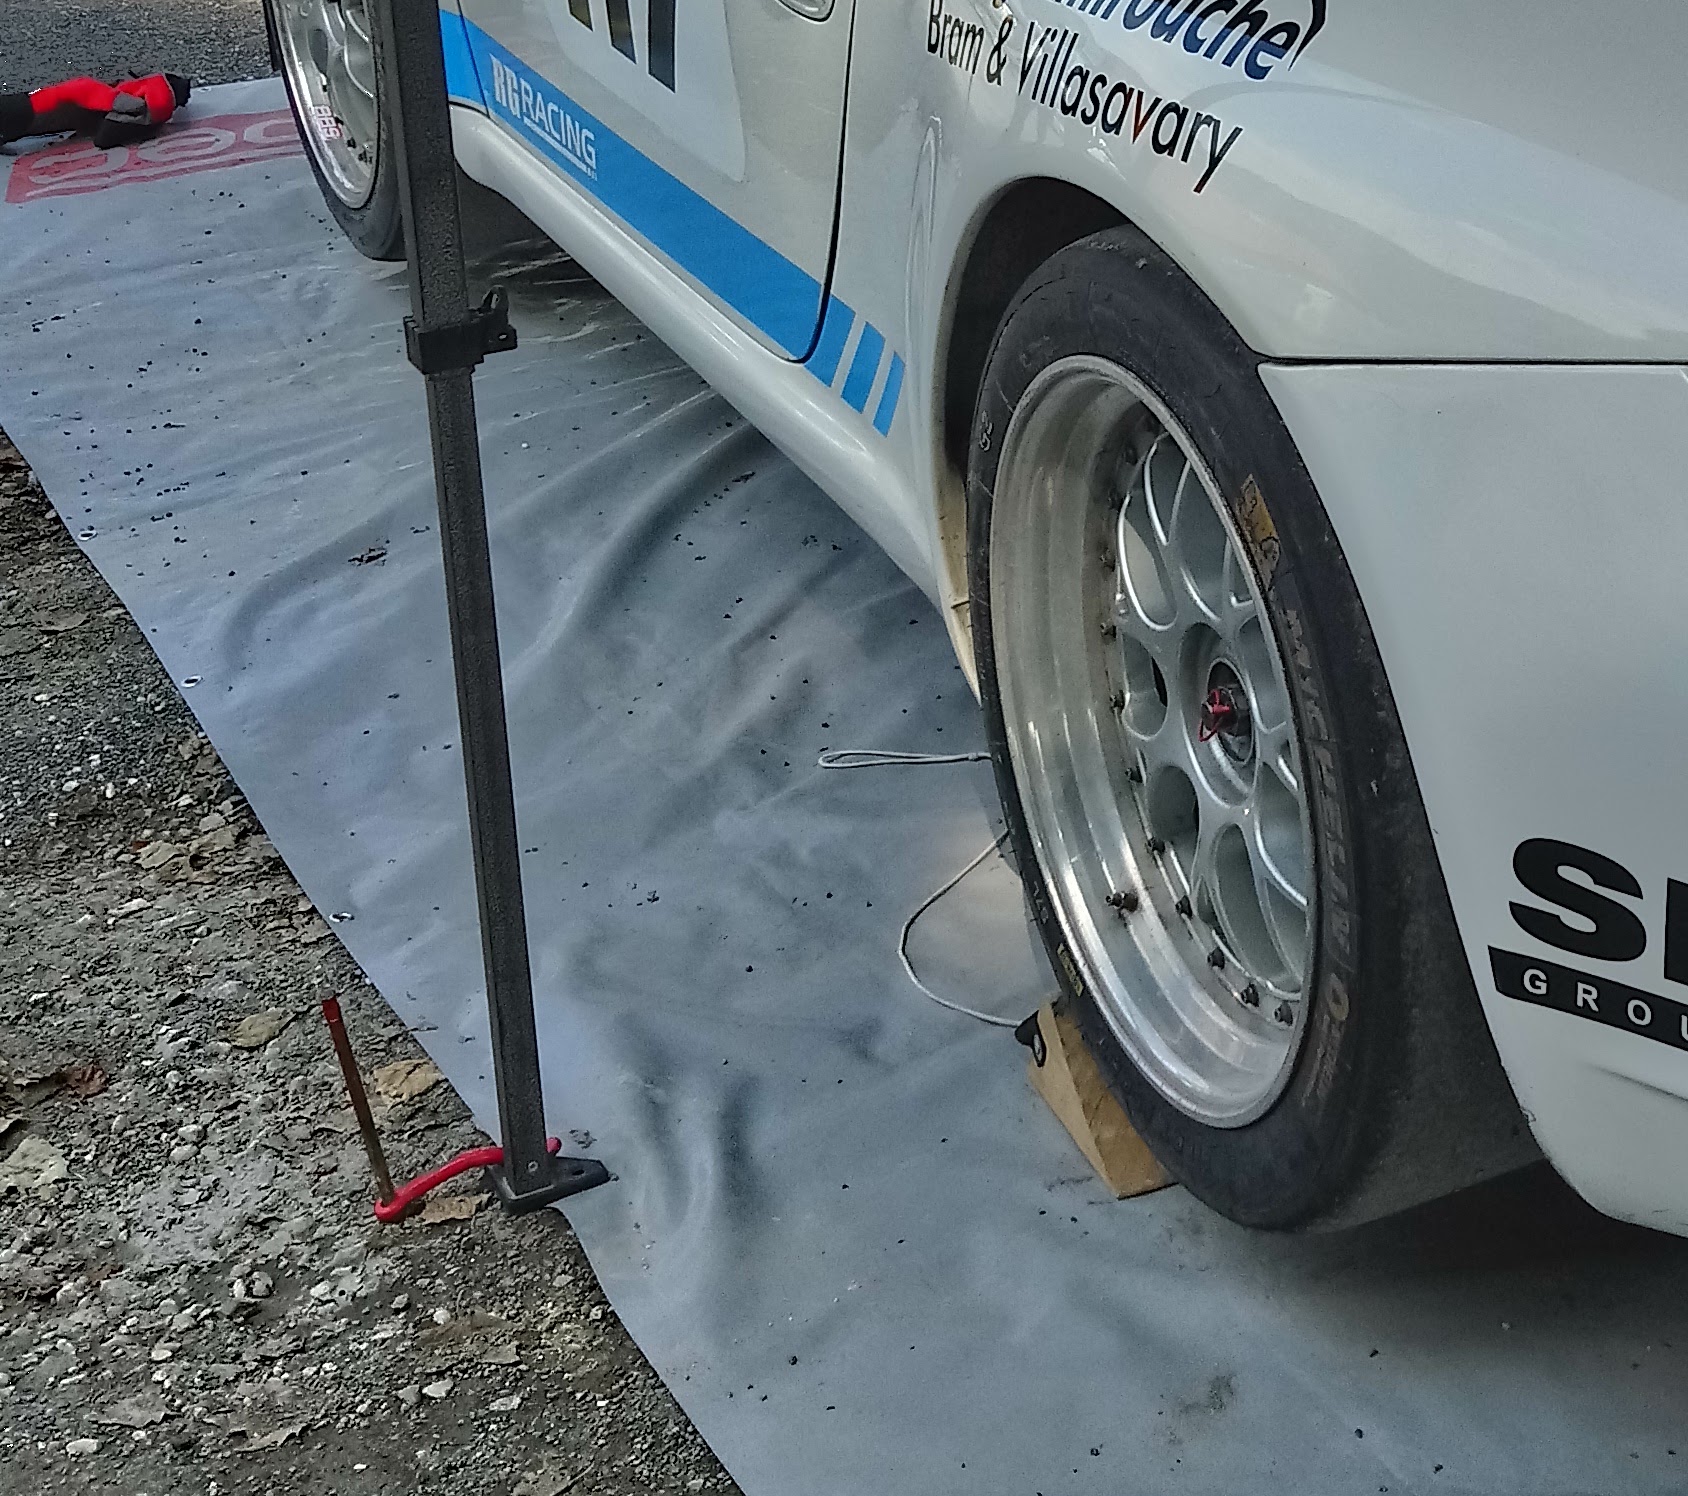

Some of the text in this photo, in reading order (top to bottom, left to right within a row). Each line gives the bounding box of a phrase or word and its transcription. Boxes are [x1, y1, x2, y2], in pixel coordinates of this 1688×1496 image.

[313, 105, 343, 141] BBS
[985, 18, 1014, 87] &
[1017, 20, 1244, 194] Villasavary
